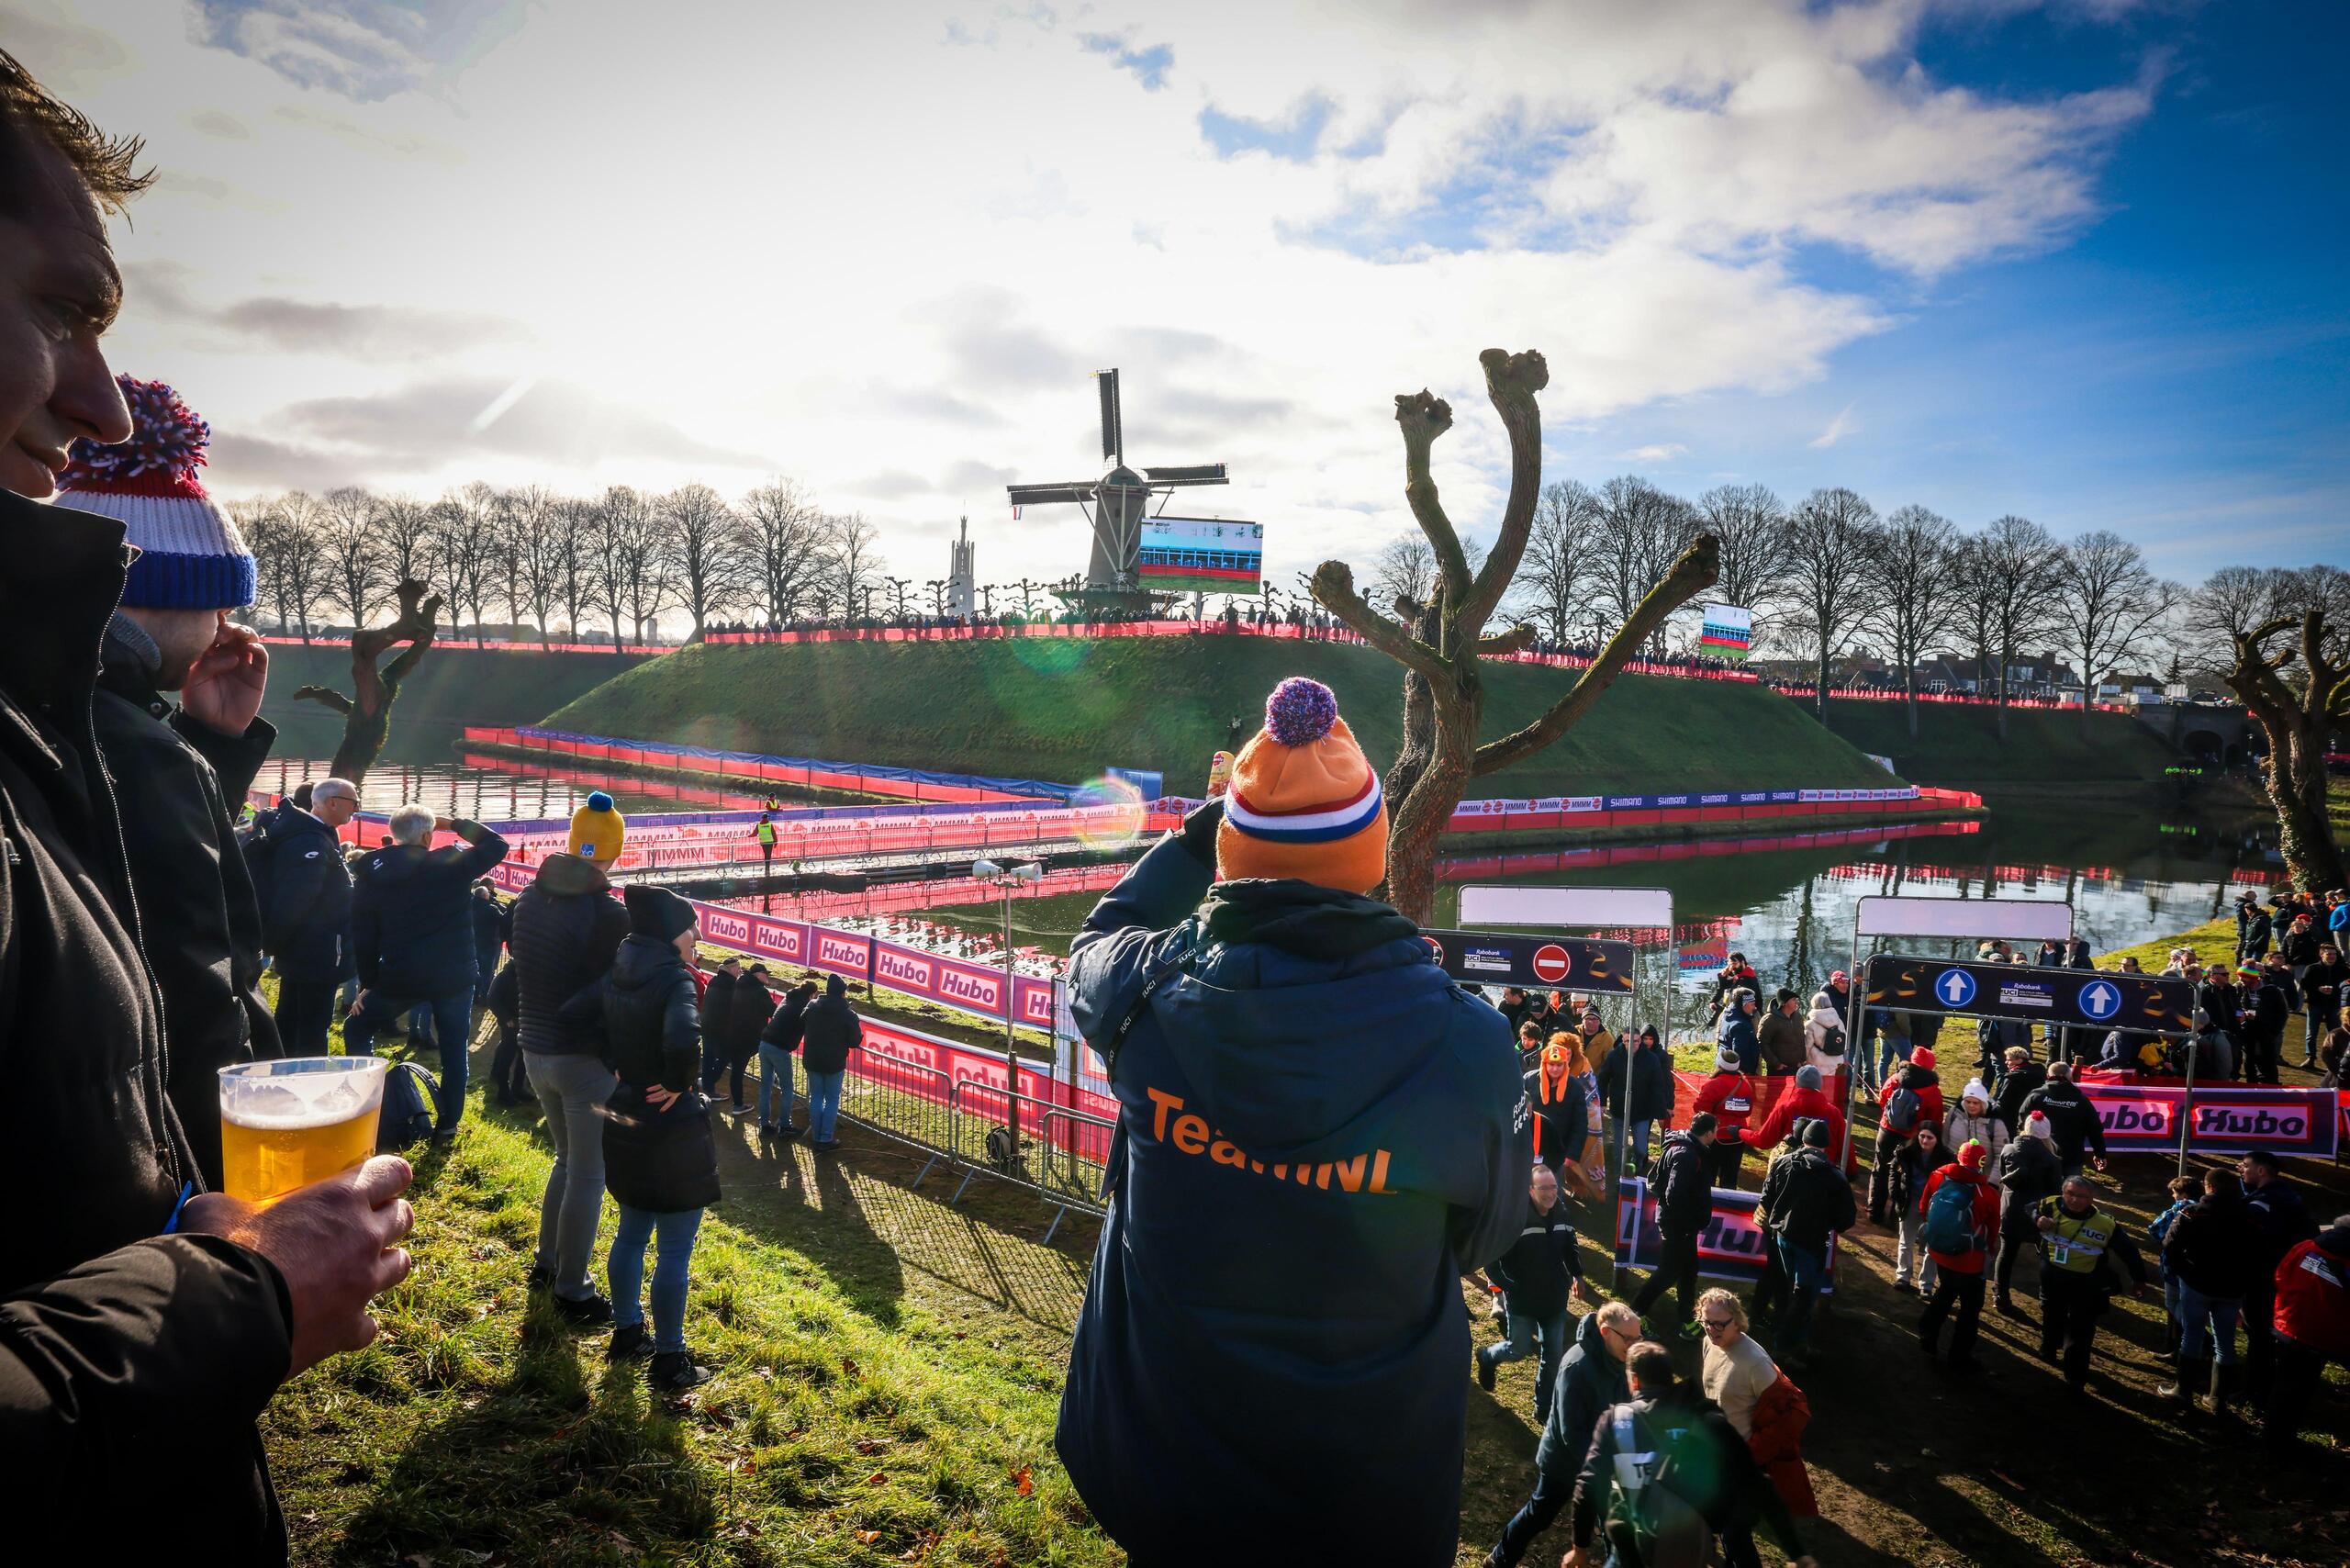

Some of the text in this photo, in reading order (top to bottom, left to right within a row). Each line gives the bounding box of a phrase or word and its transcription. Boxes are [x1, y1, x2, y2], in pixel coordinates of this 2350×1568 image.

[1610, 797, 1642, 807] SHIMANO
[1658, 796, 1687, 805] SHIMANO
[1701, 794, 1729, 803] SHIMANO
[1740, 792, 1766, 801] SHIMANO
[1772, 791, 1796, 801] SHIMANO
[647, 847, 705, 862] MMMM
[711, 917, 747, 941] Hubo
[757, 928, 797, 951] Hubo
[822, 940, 867, 966] Hubo
[879, 956, 927, 984] Hubo
[942, 971, 995, 1003] Hubo
[2013, 982, 2041, 991] Rabobank
[2093, 1104, 2165, 1132] ubo
[2197, 1108, 2306, 1137] Hubo
[2086, 1229, 2106, 1241] UCI
